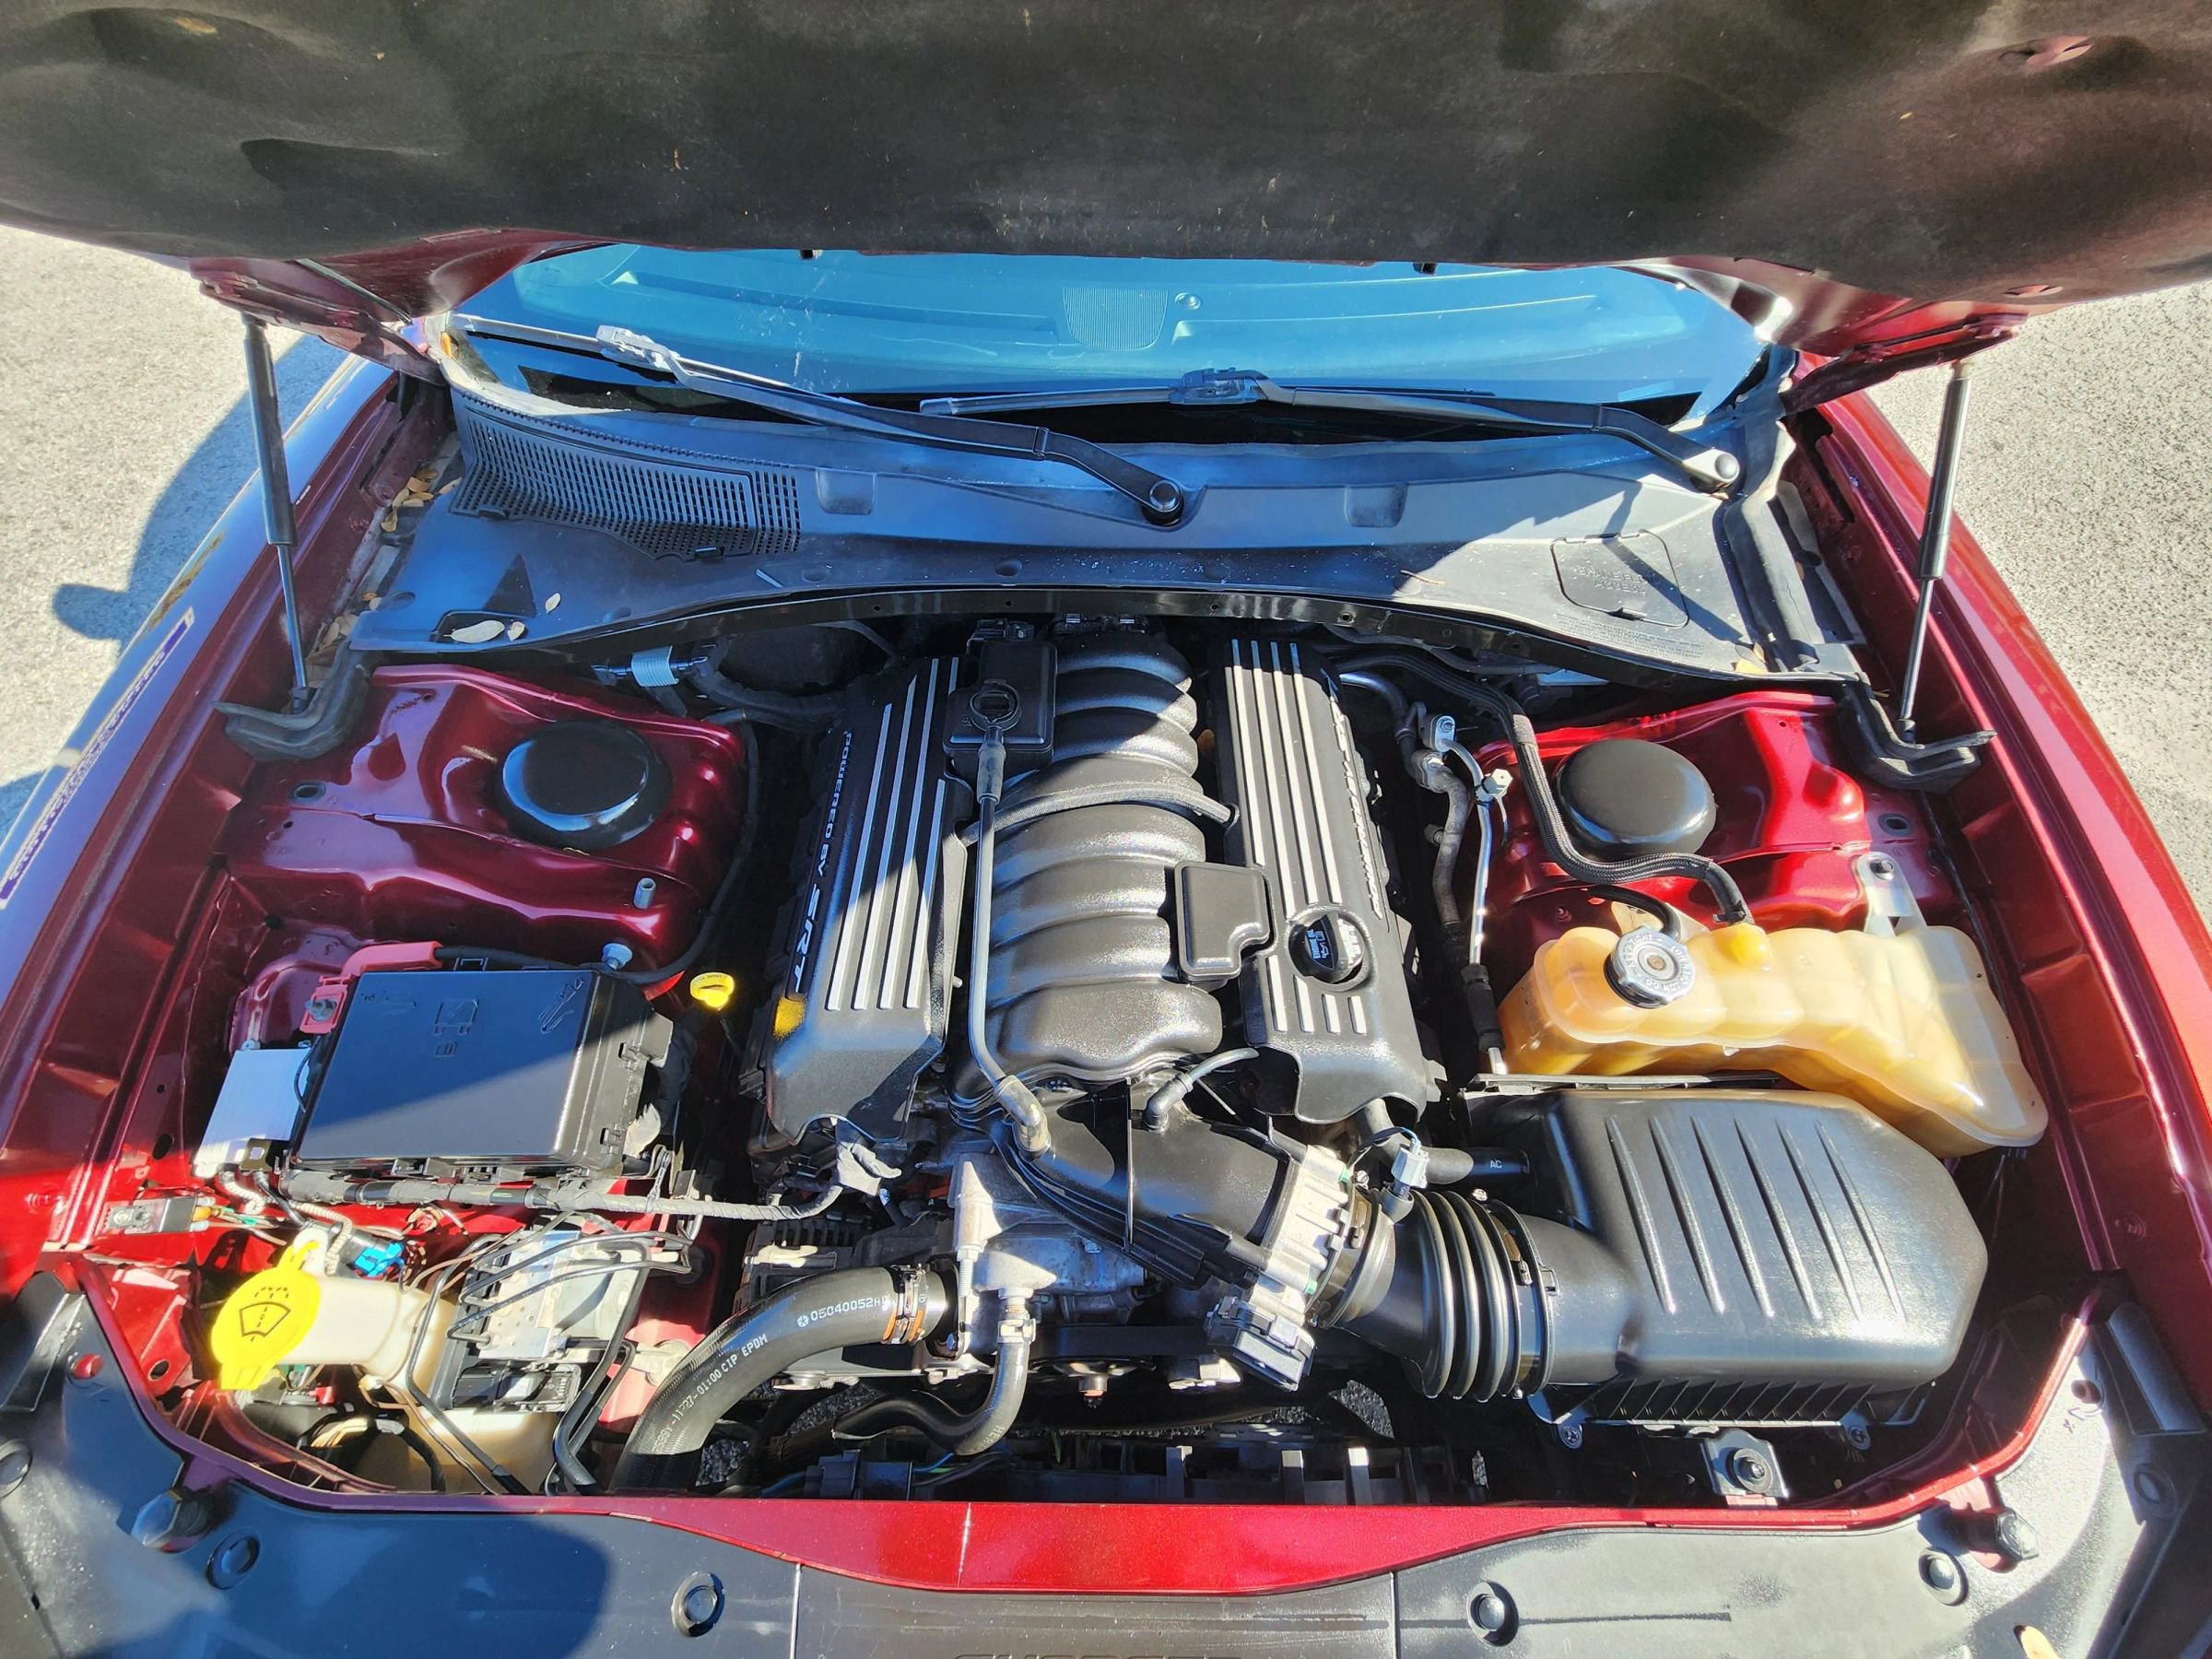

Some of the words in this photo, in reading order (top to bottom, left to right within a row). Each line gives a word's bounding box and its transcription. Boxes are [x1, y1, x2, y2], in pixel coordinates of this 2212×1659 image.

[1575, 567, 1621, 582] BRAKE
[826, 732, 852, 839] POWERED
[818, 843, 830, 877] BY
[794, 883, 820, 994] SRT
[1489, 1159, 1502, 1169] AC
[721, 1354, 738, 1372] CIP
[741, 1333, 769, 1358] EPDM
